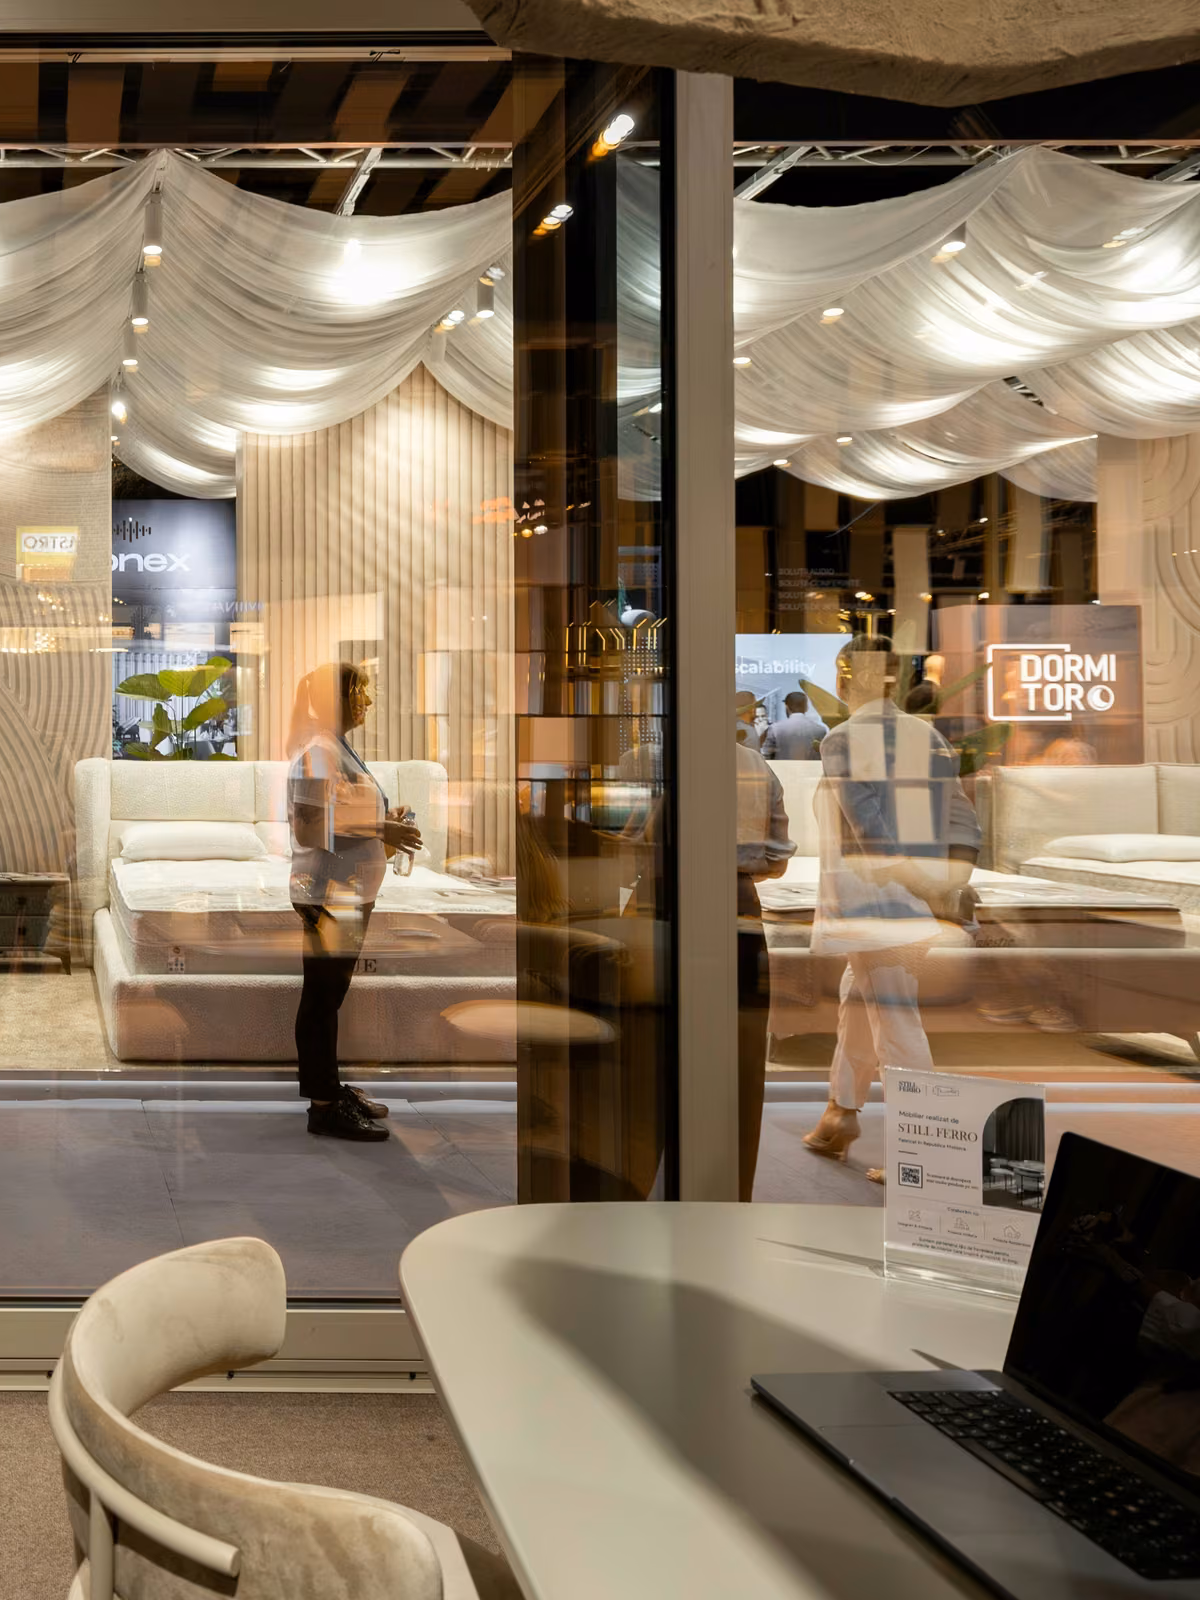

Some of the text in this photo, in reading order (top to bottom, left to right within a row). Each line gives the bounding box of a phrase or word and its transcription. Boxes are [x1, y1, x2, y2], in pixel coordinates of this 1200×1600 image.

[112, 552, 191, 573] nex
[1020, 653, 1116, 682] DORMI
[898, 1110, 959, 1125] Mobilier realizat de
[898, 1122, 978, 1143] STILL FERRO
